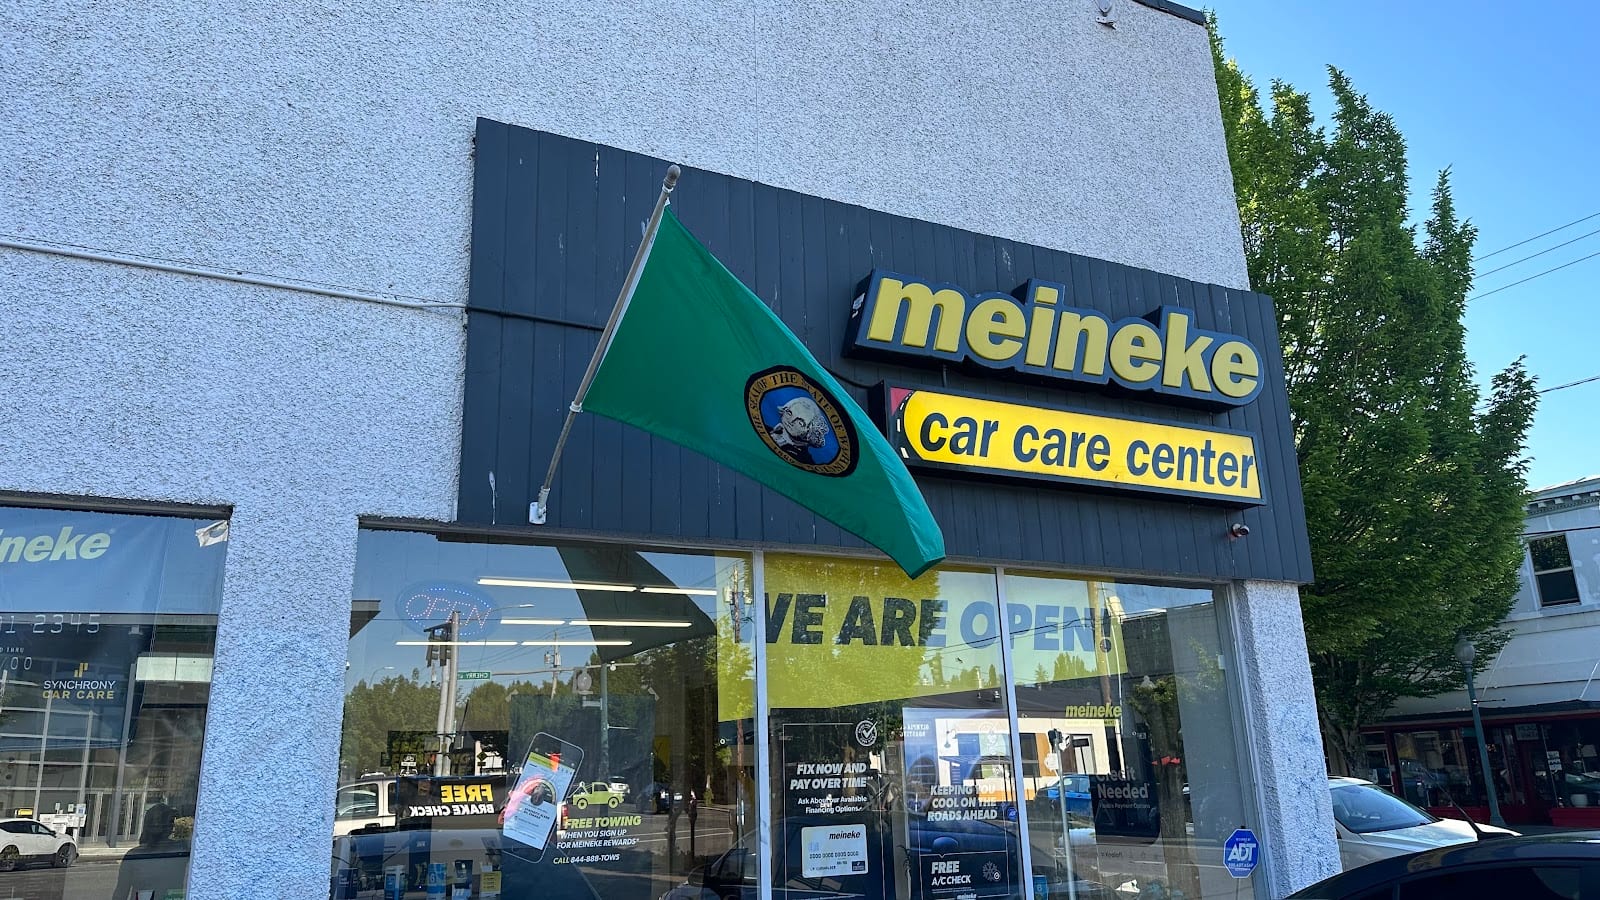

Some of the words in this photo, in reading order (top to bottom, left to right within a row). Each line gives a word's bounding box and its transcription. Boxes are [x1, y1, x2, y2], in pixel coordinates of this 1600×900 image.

[868, 277, 1259, 398] meineke
[769, 372, 798, 386] THE
[919, 412, 999, 458] car
[1013, 424, 1111, 472] care
[1126, 438, 1255, 489] center
[0, 526, 111, 563] neke
[405, 593, 492, 629] OPEN
[33, 613, 101, 634] 2345
[838, 595, 949, 648] ARE
[959, 600, 1112, 654] OPEN!
[43, 680, 116, 690] SYNCHRONY
[42, 690, 70, 700] CAR
[76, 690, 115, 700] CARE
[1065, 702, 1122, 718] meineke
[797, 764, 816, 775] FIX
[816, 763, 844, 775] NOW
[843, 762, 867, 774] AND
[790, 779, 812, 790] PAY
[812, 778, 840, 790] OVER
[930, 785, 973, 796] KEEPING
[840, 795, 868, 803] Available
[932, 798, 960, 808] COOL
[960, 797, 976, 808] ON
[806, 806, 834, 814] Financing
[928, 811, 962, 822] ROADS
[962, 810, 998, 820] AHEAD
[564, 818, 593, 829] FREE
[594, 816, 642, 828] TOWING
[560, 831, 583, 840] WHEN
[828, 830, 860, 840] meineke
[556, 842, 571, 850] FOR
[572, 840, 602, 848] MEINEKE
[1228, 842, 1256, 862] ADT
[931, 860, 960, 874] FREE
[931, 878, 946, 886] A/C
[946, 874, 972, 885] CHECK
